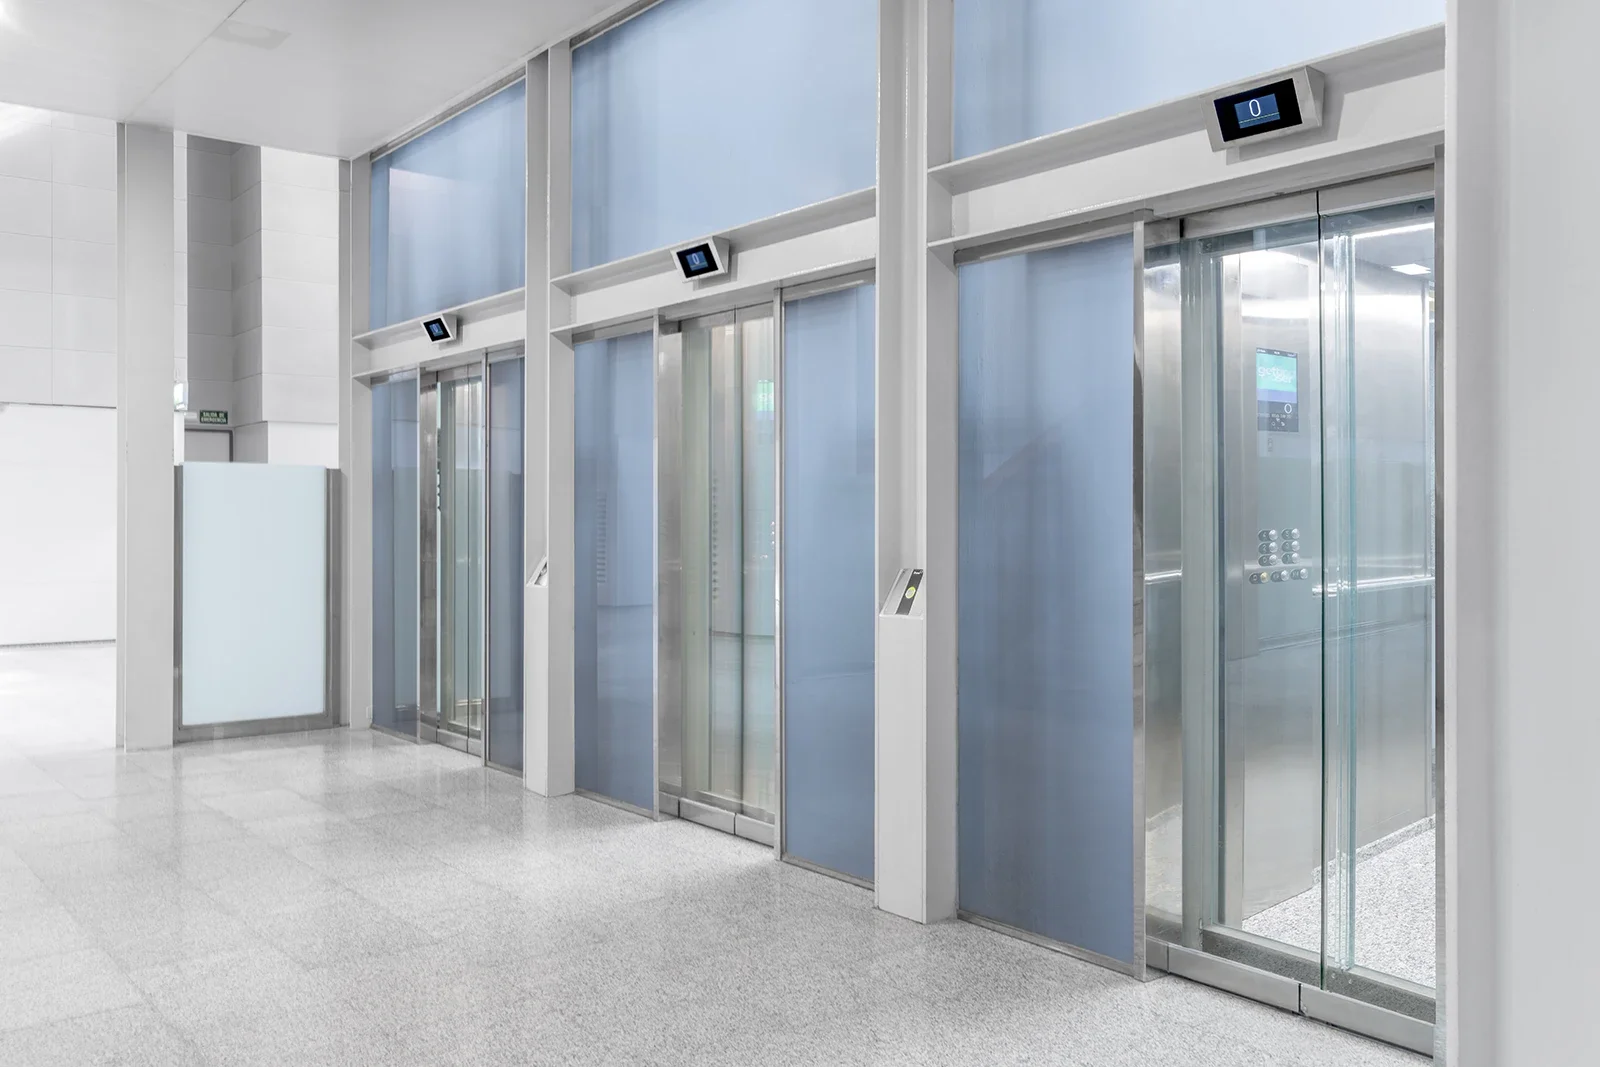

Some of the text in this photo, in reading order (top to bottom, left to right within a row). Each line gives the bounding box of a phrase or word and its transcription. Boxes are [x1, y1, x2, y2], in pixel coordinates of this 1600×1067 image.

[1249, 99, 1261, 117] 0
[692, 253, 700, 264] 0
[1284, 404, 1292, 414] 0
